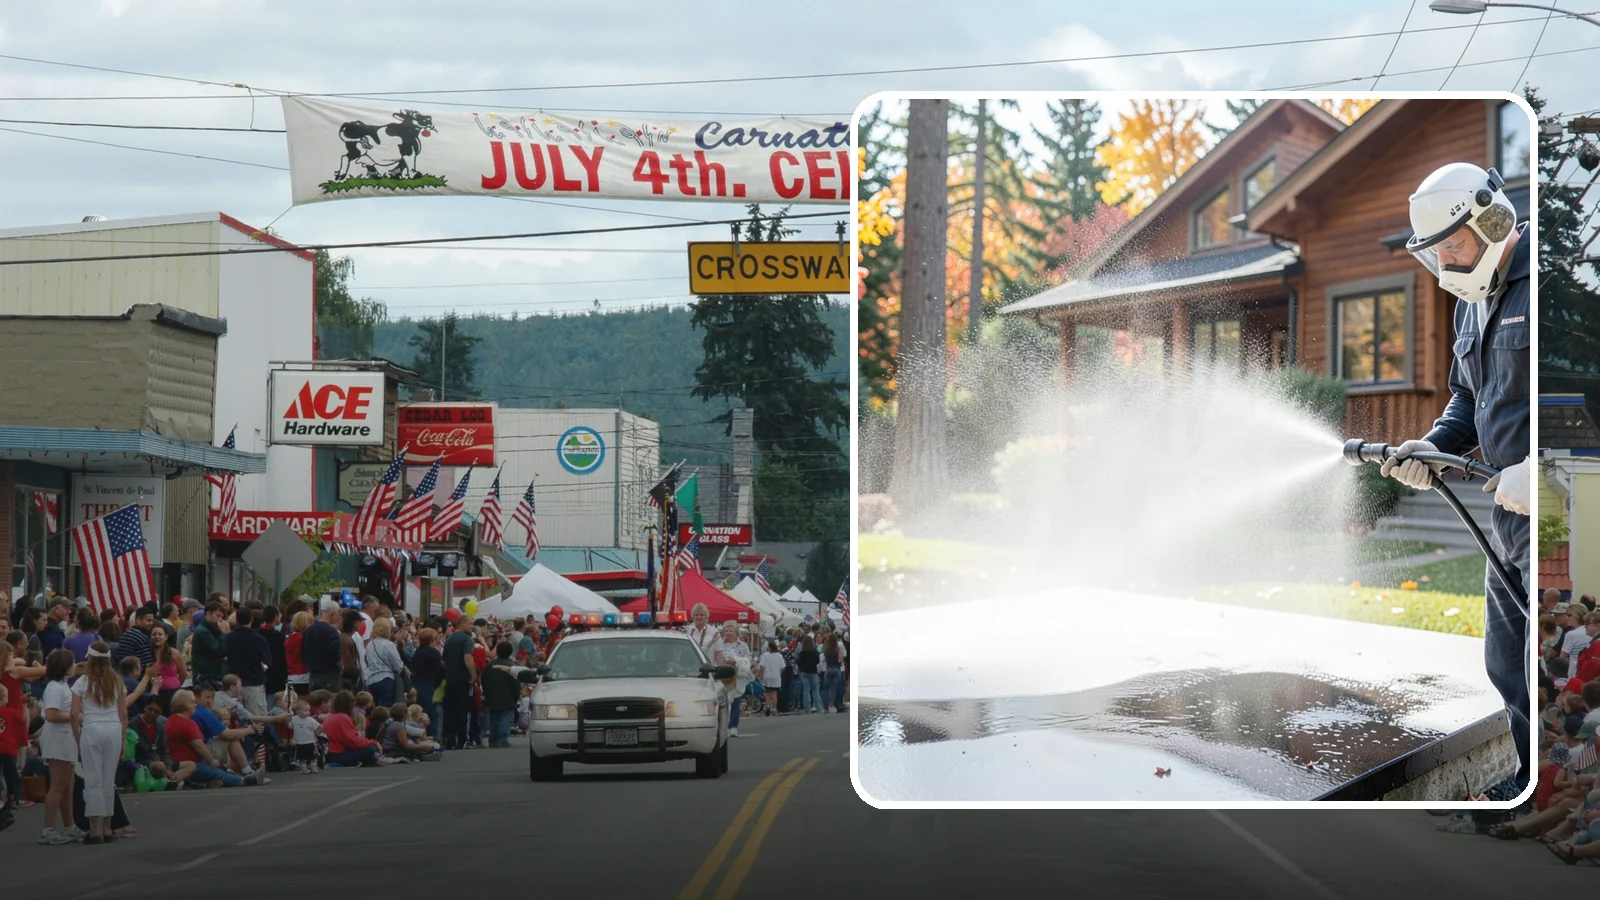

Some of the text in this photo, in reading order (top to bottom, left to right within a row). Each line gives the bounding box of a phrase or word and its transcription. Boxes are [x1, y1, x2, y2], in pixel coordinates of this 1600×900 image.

[481, 141, 605, 193] JULY
[632, 150, 747, 197] 4th.
[697, 254, 850, 280] CROSSWA
[283, 380, 373, 420] ACE
[406, 409, 452, 422] CEDAR
[283, 421, 371, 436] Hardware
[416, 428, 478, 447] Coca-Cola
[83, 485, 155, 495] St. Vincent de Paul
[688, 526, 741, 535] CRNATION
[699, 535, 730, 543] GLASS
